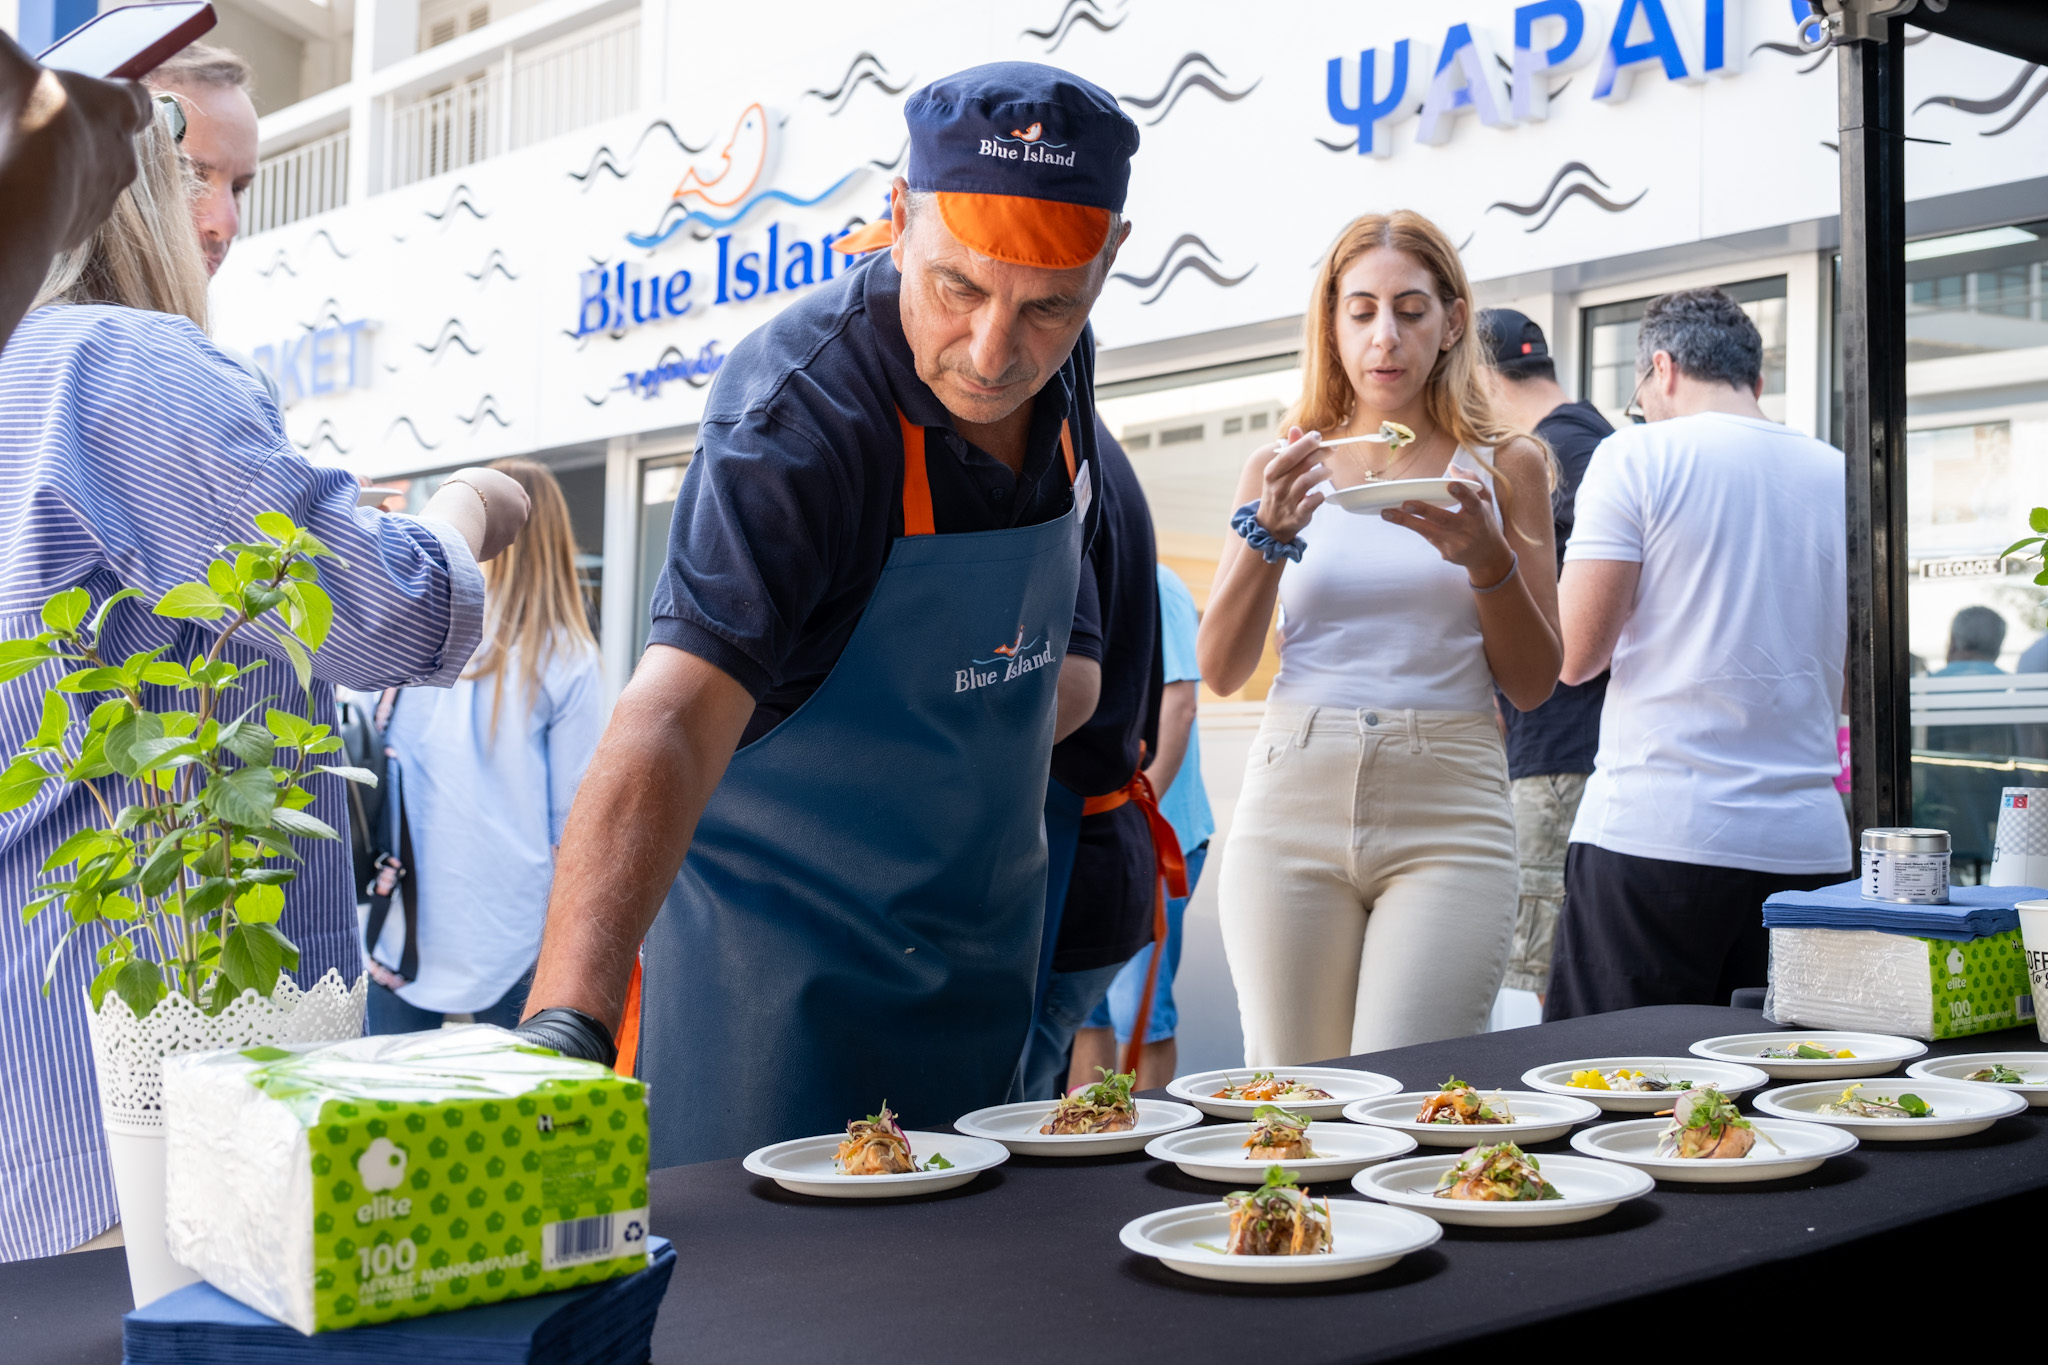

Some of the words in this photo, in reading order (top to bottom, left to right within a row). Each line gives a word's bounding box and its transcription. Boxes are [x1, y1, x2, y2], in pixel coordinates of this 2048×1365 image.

[979, 139, 1018, 160] Blue
[1023, 145, 1076, 167] Island
[576, 261, 693, 336] Blue
[714, 221, 868, 305] Islan
[955, 667, 997, 693] Blue
[1003, 641, 1051, 682] Island
[1947, 976, 1967, 991] elite
[1949, 1000, 1971, 1018] 100
[357, 1195, 412, 1224] elite
[358, 1238, 417, 1279] 100
